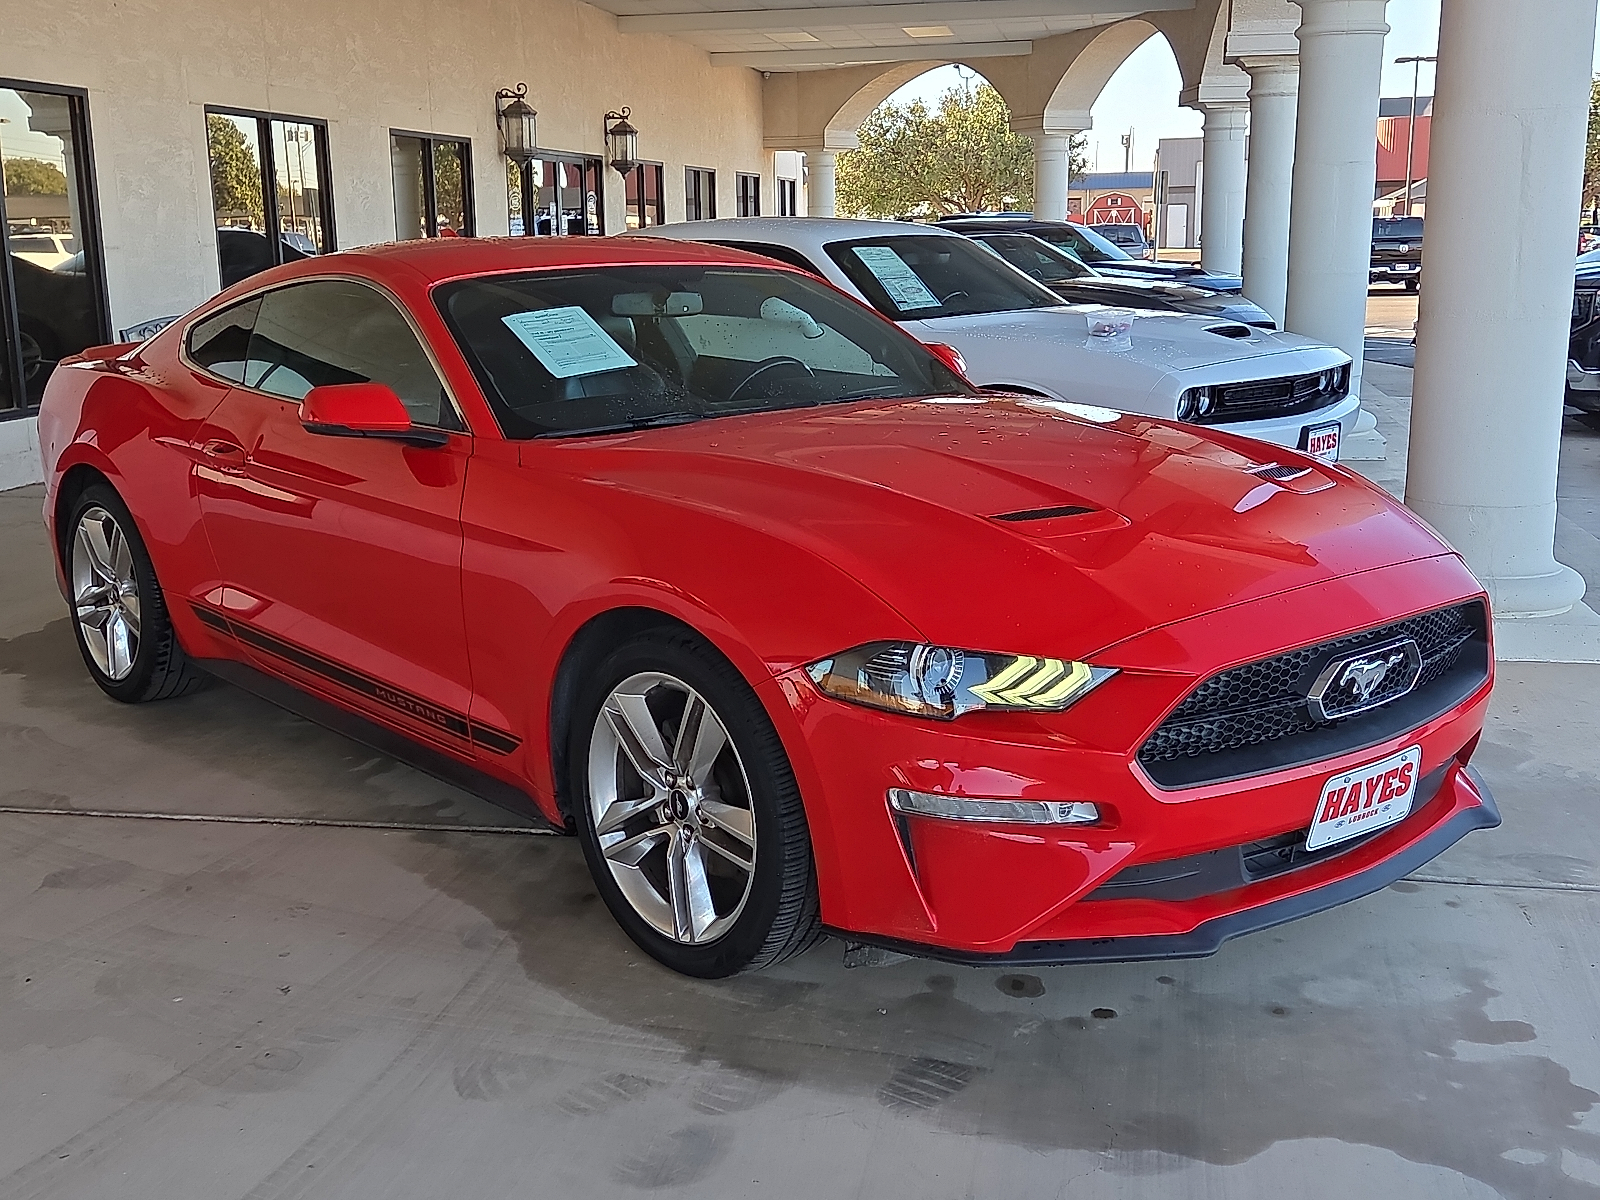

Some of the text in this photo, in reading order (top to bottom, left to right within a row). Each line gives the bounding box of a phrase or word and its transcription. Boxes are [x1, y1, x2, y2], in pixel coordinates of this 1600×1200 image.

[1310, 433, 1337, 453] HAYES
[375, 688, 447, 724] MUSTANG
[1319, 762, 1413, 823] HAYES
[1348, 808, 1380, 824] LUBBOCK
